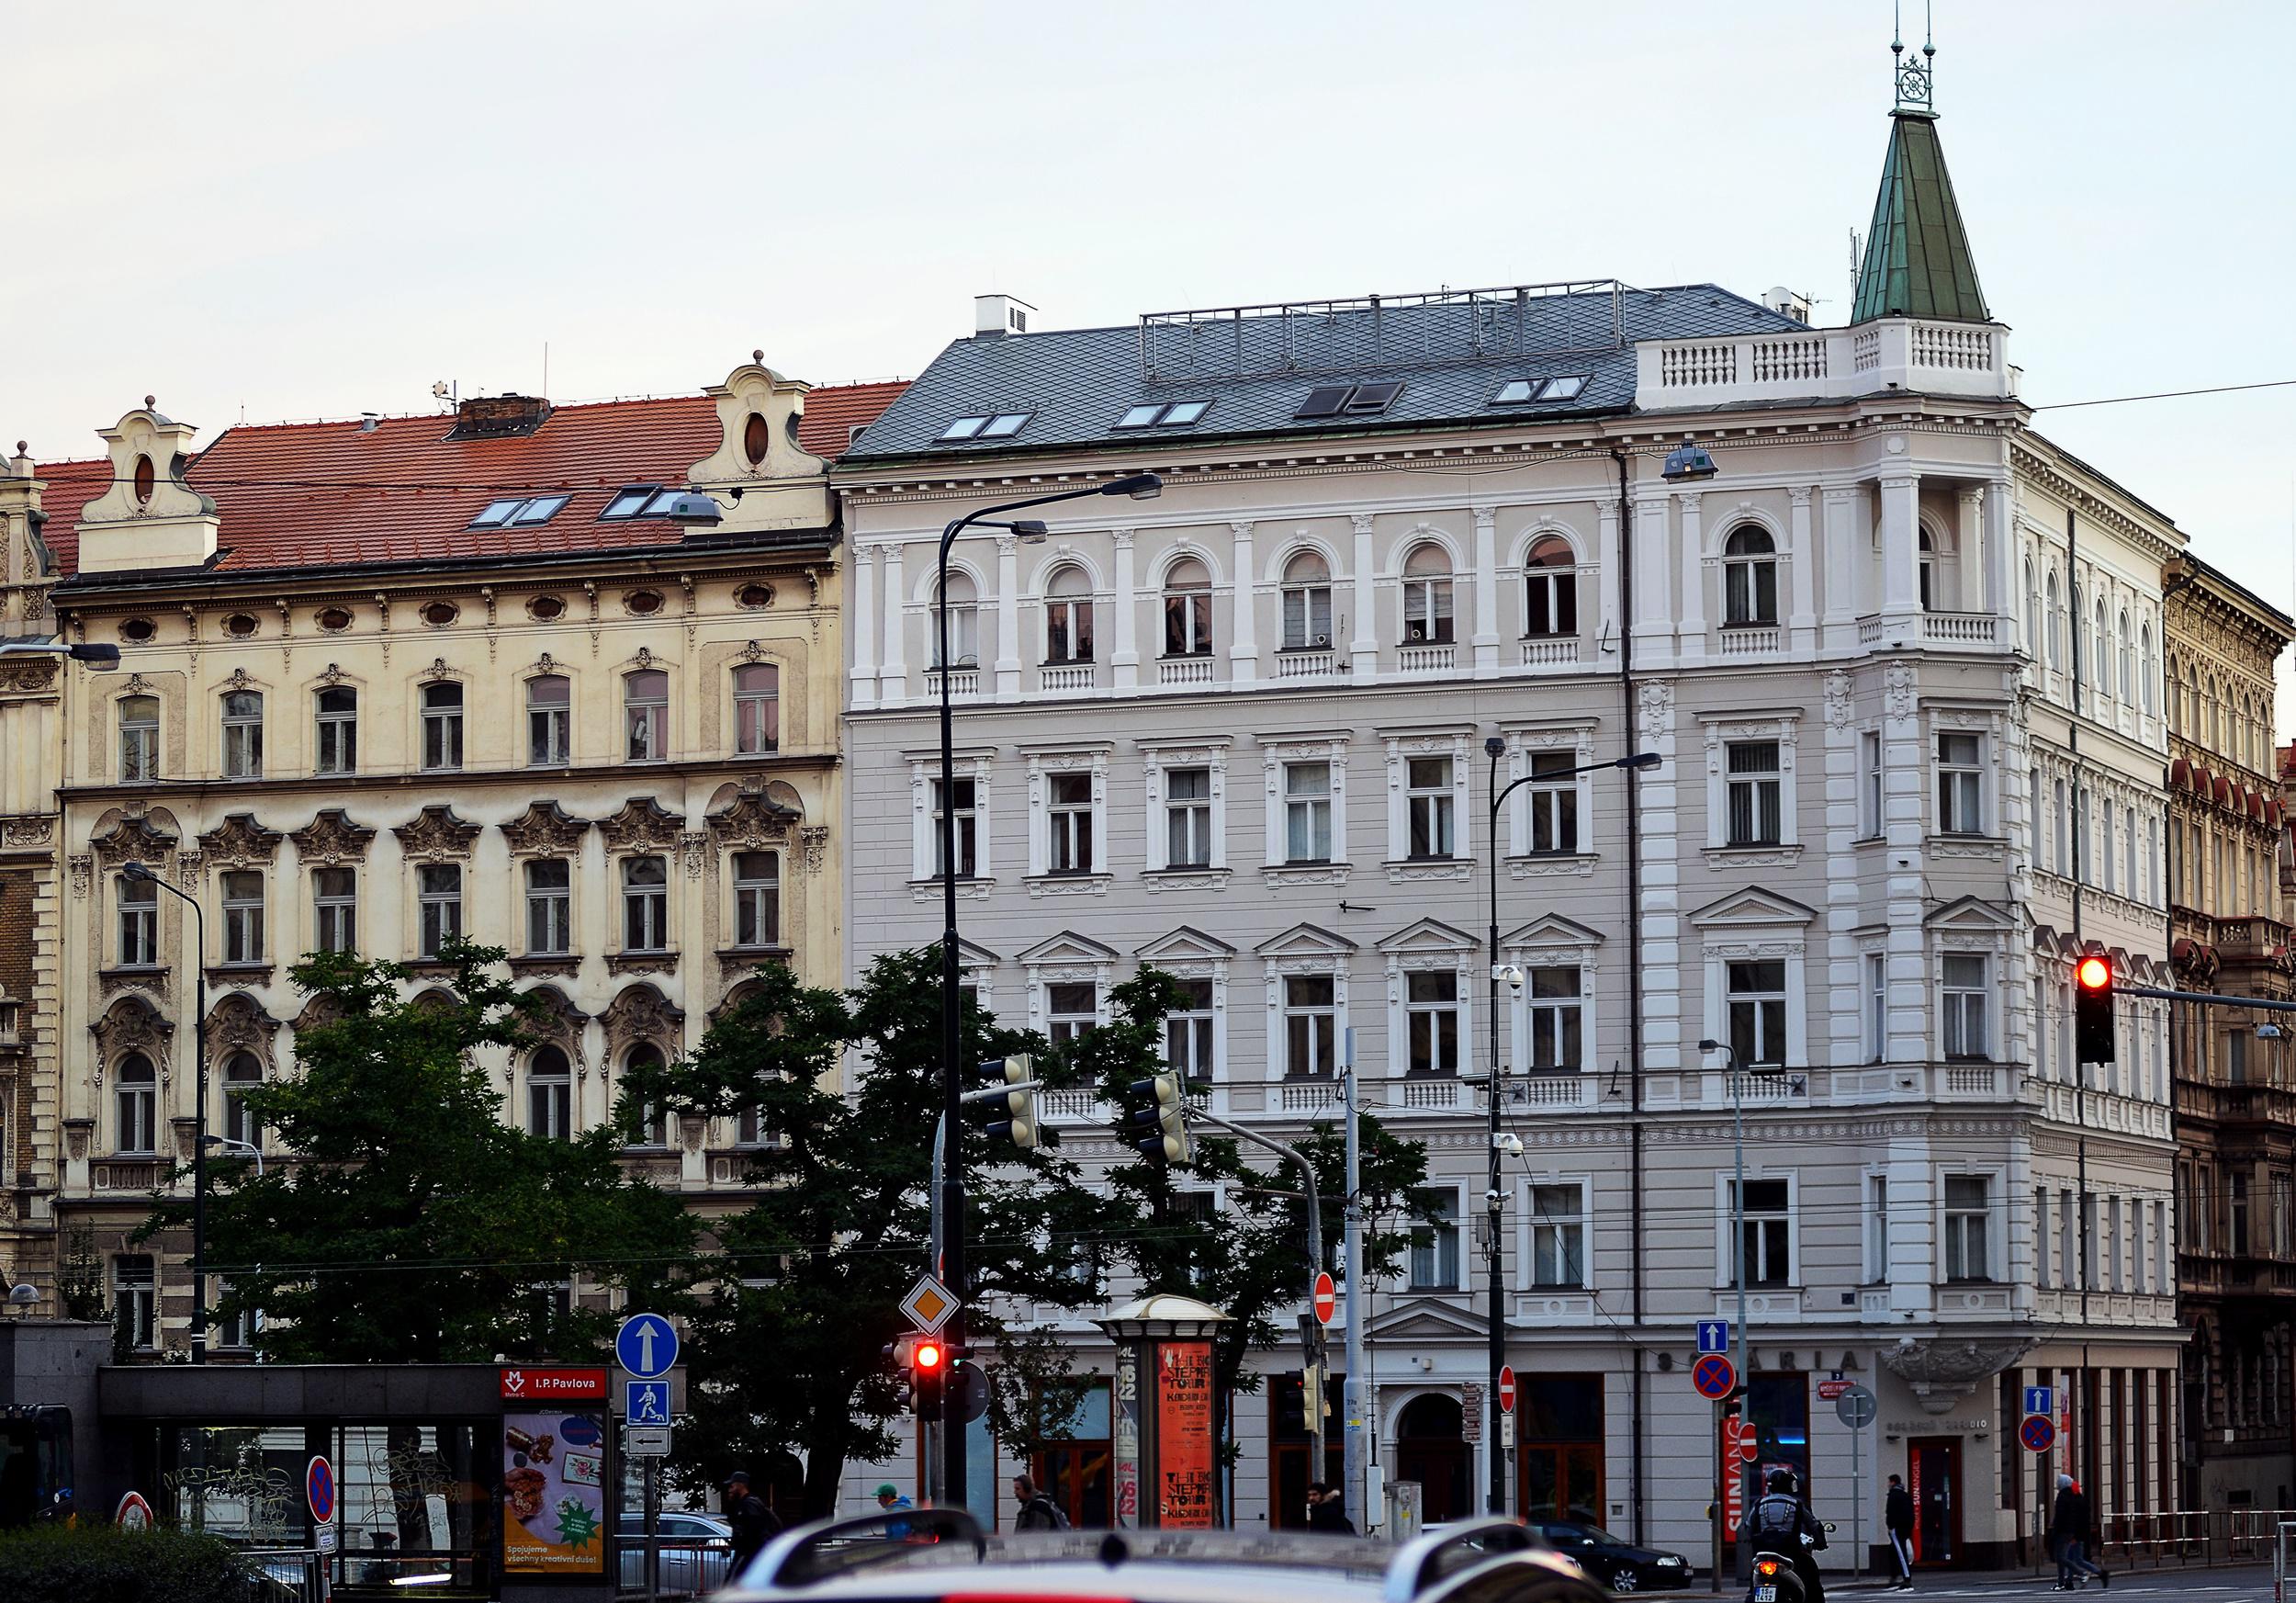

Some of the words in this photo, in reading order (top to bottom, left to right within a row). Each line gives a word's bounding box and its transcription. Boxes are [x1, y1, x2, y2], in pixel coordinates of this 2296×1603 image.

[1658, 1347, 1858, 1371] SÁRIA
[535, 1379, 551, 1388] I.P.
[553, 1378, 596, 1388] Pavlova
[1912, 1459, 1921, 1506] SUNANGEL
[507, 1545, 548, 1555] Spojujeme
[507, 1554, 540, 1564] všechny
[540, 1554, 575, 1563] kreativní
[575, 1555, 597, 1563] duše!
